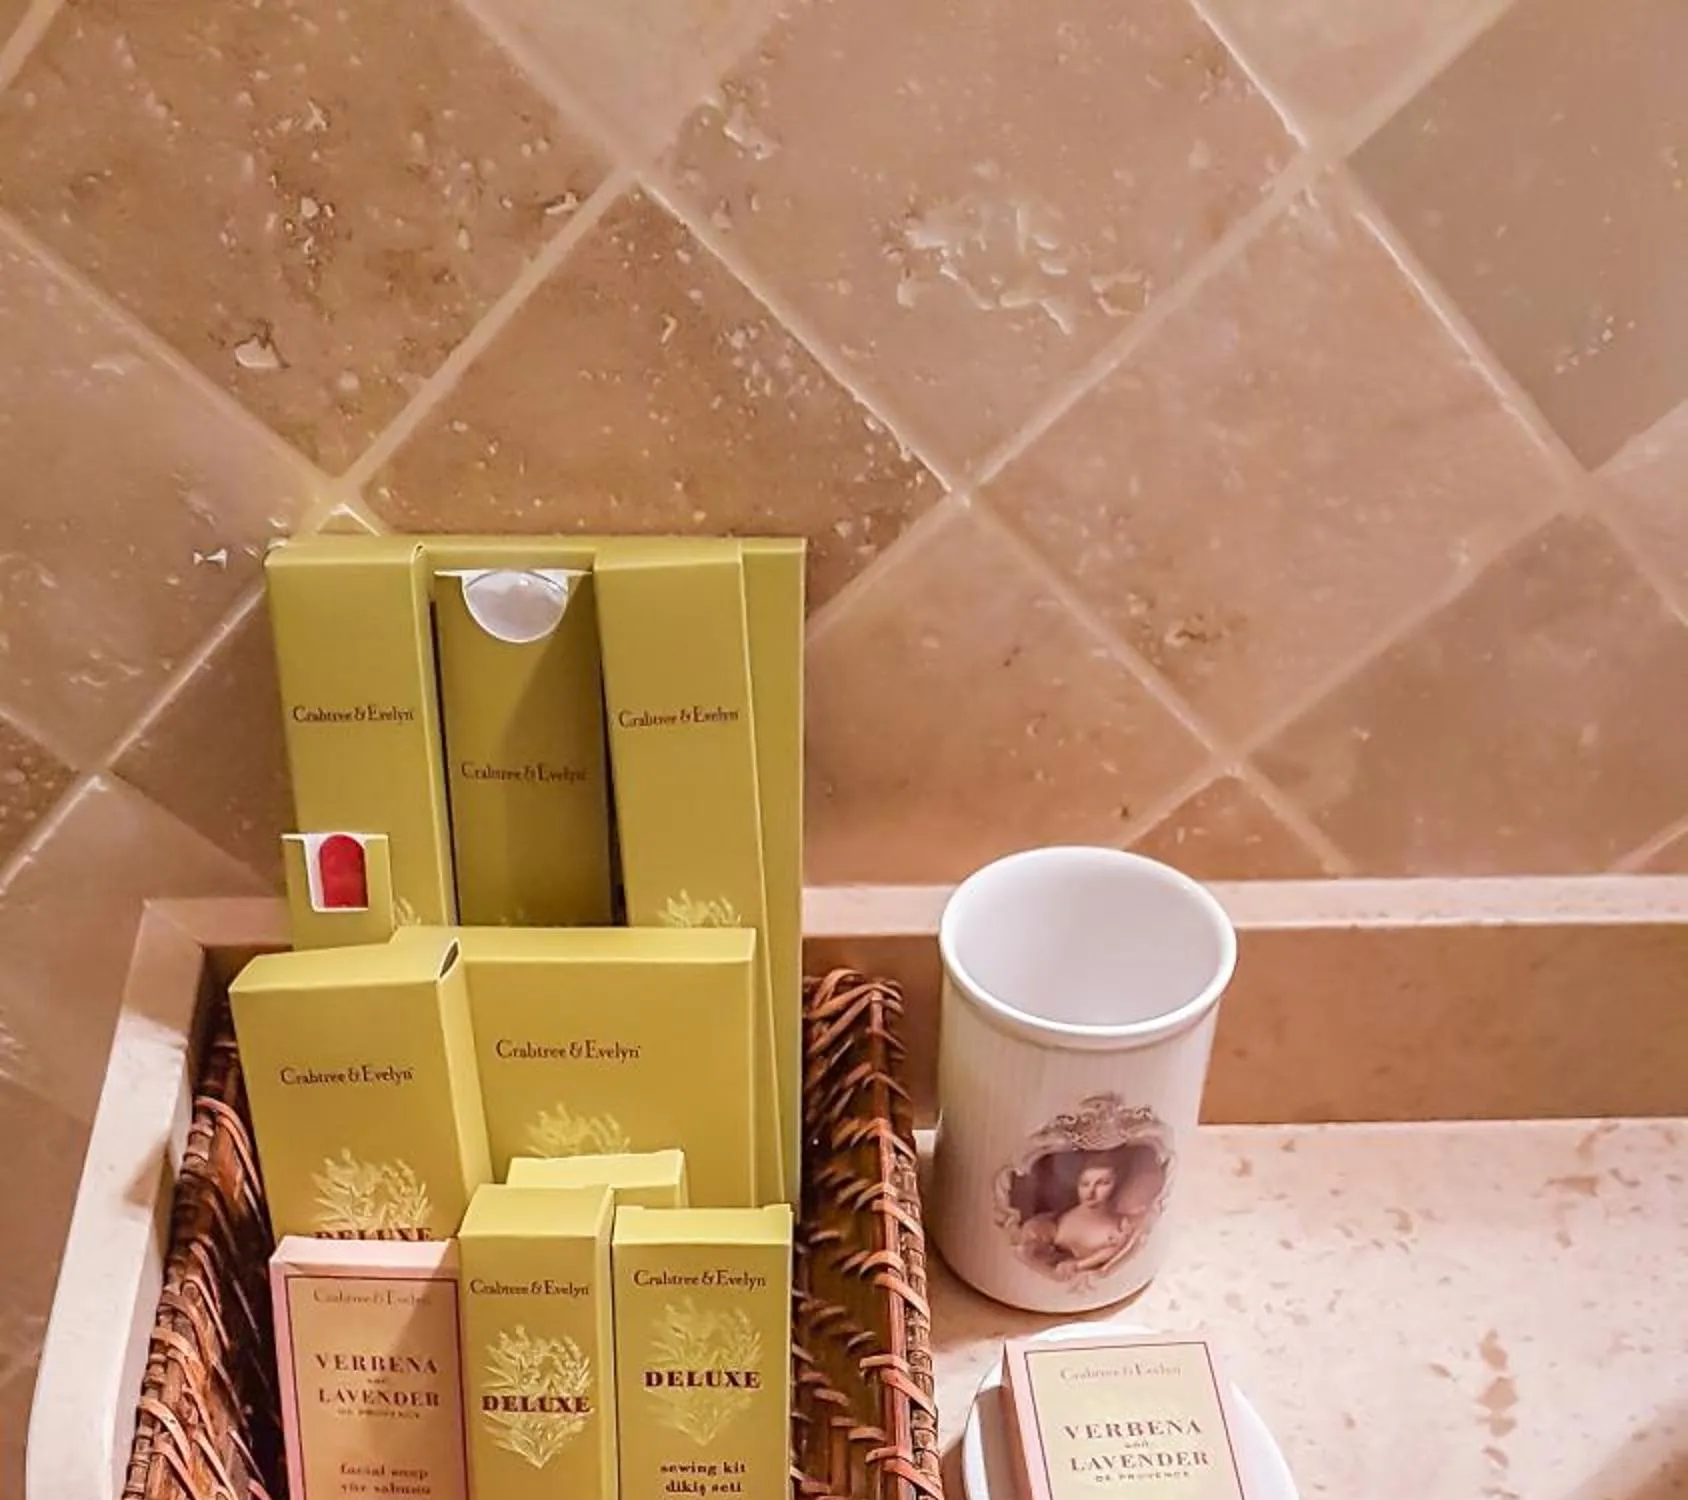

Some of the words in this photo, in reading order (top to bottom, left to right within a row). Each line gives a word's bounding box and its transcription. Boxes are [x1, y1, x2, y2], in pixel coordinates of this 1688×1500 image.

[293, 705, 352, 722] Crabtree
[354, 706, 366, 721] &
[494, 1039, 567, 1059] Crabtree
[569, 1041, 583, 1058] &
[585, 1039, 641, 1064] Evelyn
[280, 1066, 346, 1085] Crabtree
[347, 1067, 360, 1083] &
[361, 1064, 414, 1086] Evelyn
[469, 1279, 528, 1296] Crabtree
[530, 1280, 543, 1296] &
[544, 1279, 590, 1299] Evelyn
[632, 1269, 700, 1287] Crabtree
[701, 1270, 715, 1287] &
[716, 1268, 767, 1291] Evelyn
[315, 1353, 439, 1375] VERBENA
[643, 1370, 762, 1390] DELUXE
[318, 1387, 440, 1408] LAVENDER
[481, 1395, 592, 1414] DELUXE
[1064, 1418, 1203, 1441] VERBENA
[660, 1462, 717, 1477] sewing
[723, 1461, 747, 1474] kit
[1070, 1450, 1209, 1473] LAVENDER
[711, 1480, 743, 1494] seti
